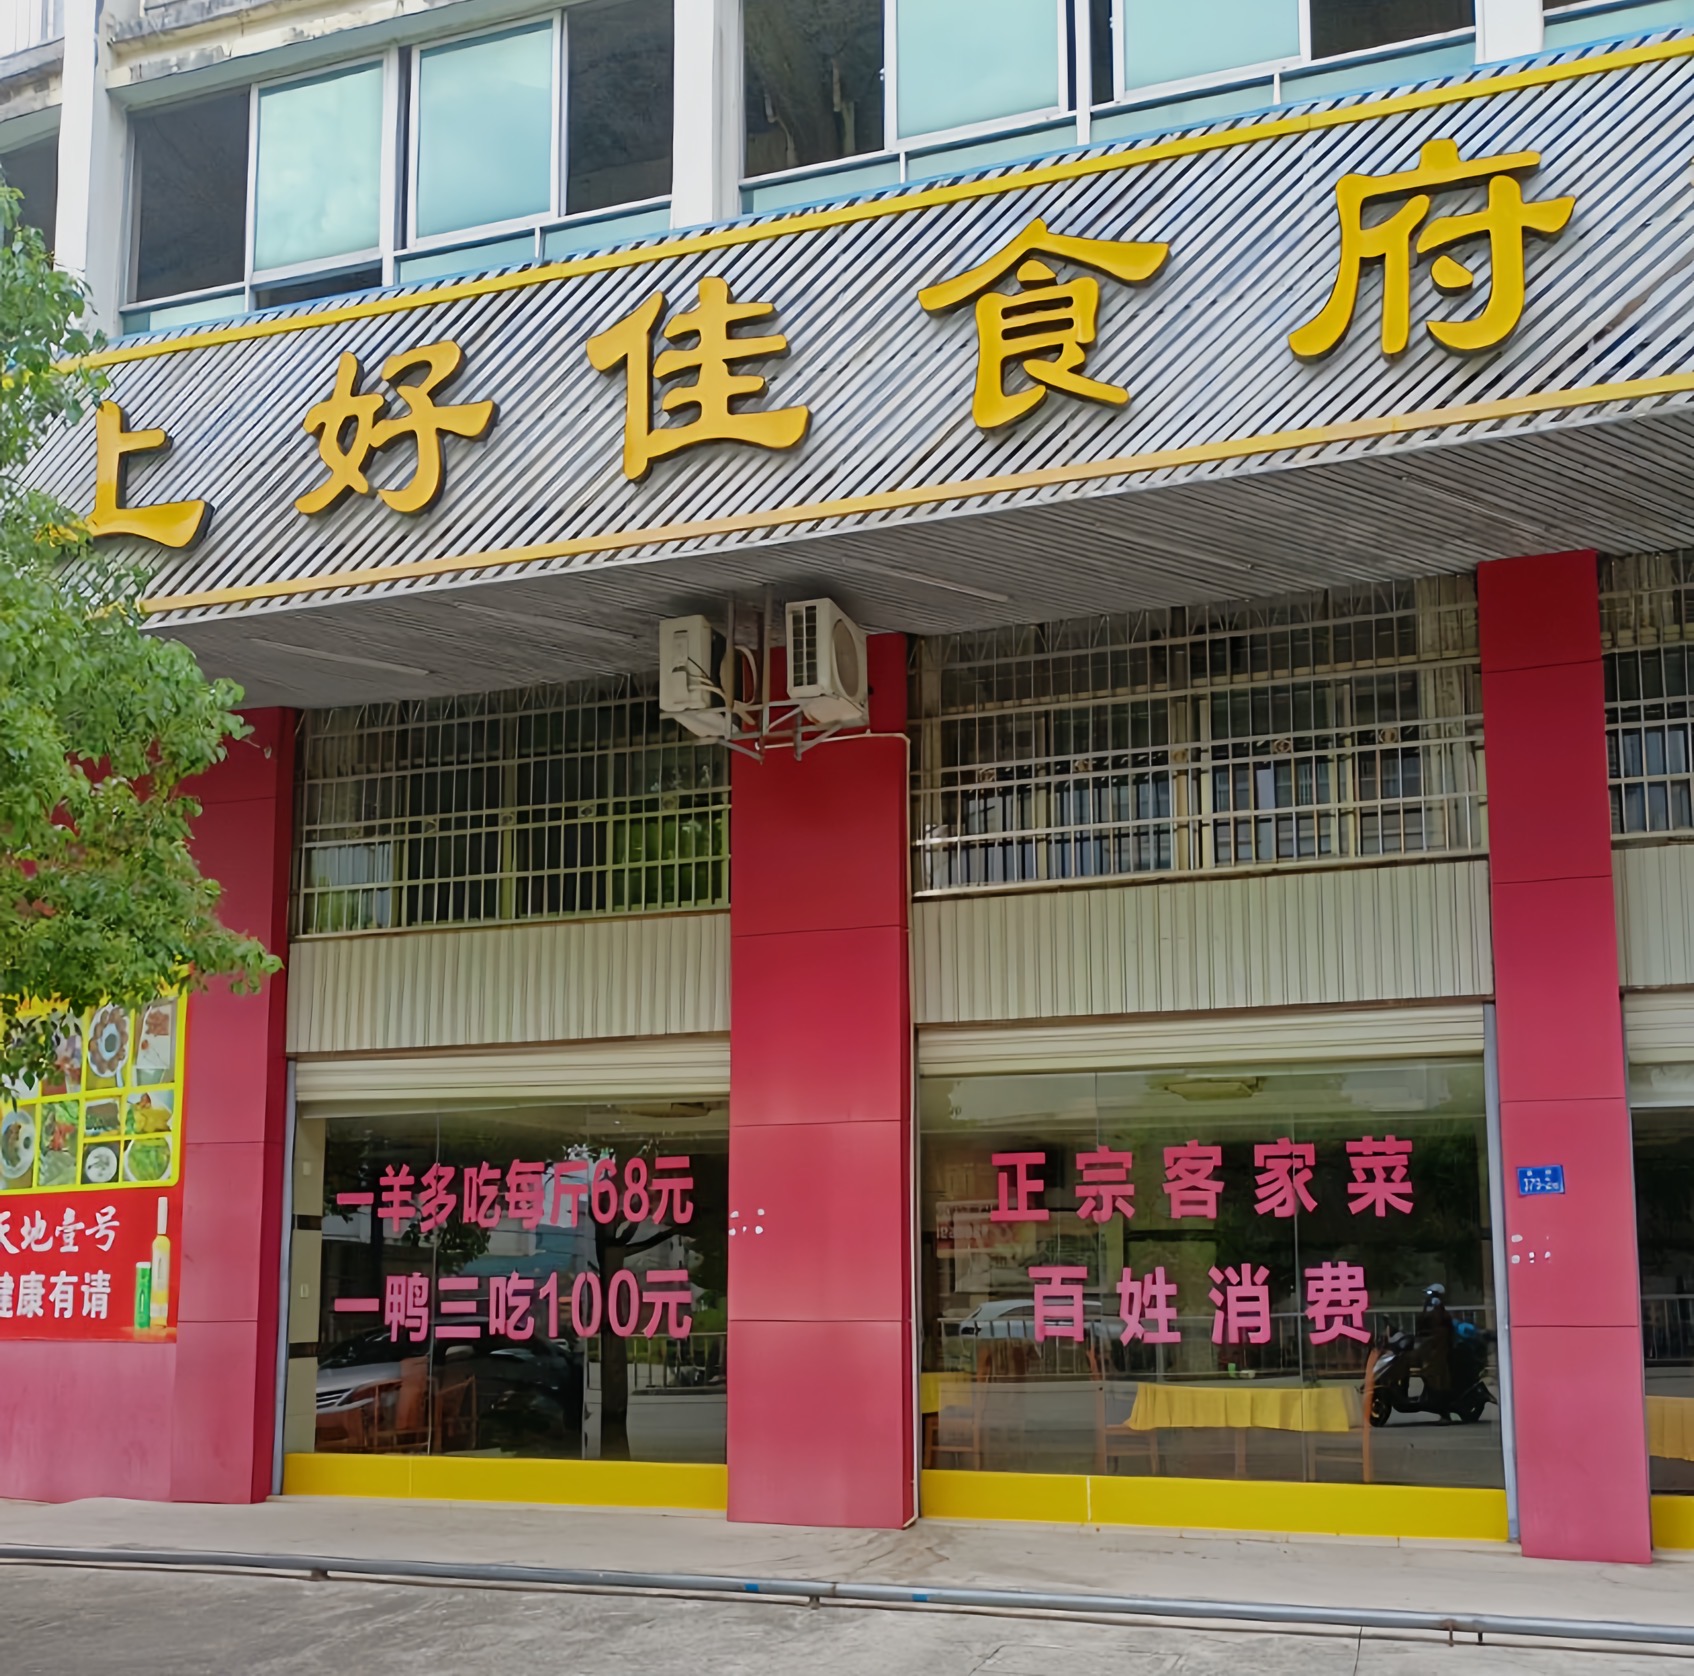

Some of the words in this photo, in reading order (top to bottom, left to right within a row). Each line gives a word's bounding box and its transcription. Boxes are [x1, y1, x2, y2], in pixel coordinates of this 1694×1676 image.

[86, 138, 1576, 549] 上好佳食府
[338, 1157, 692, 1230] 一羊多吃每斤68元
[992, 1137, 1412, 1221] 正宗客家菜
[337, 1271, 690, 1341] 一鸭三吃100元
[1030, 1265, 1368, 1343] 百姓消费
